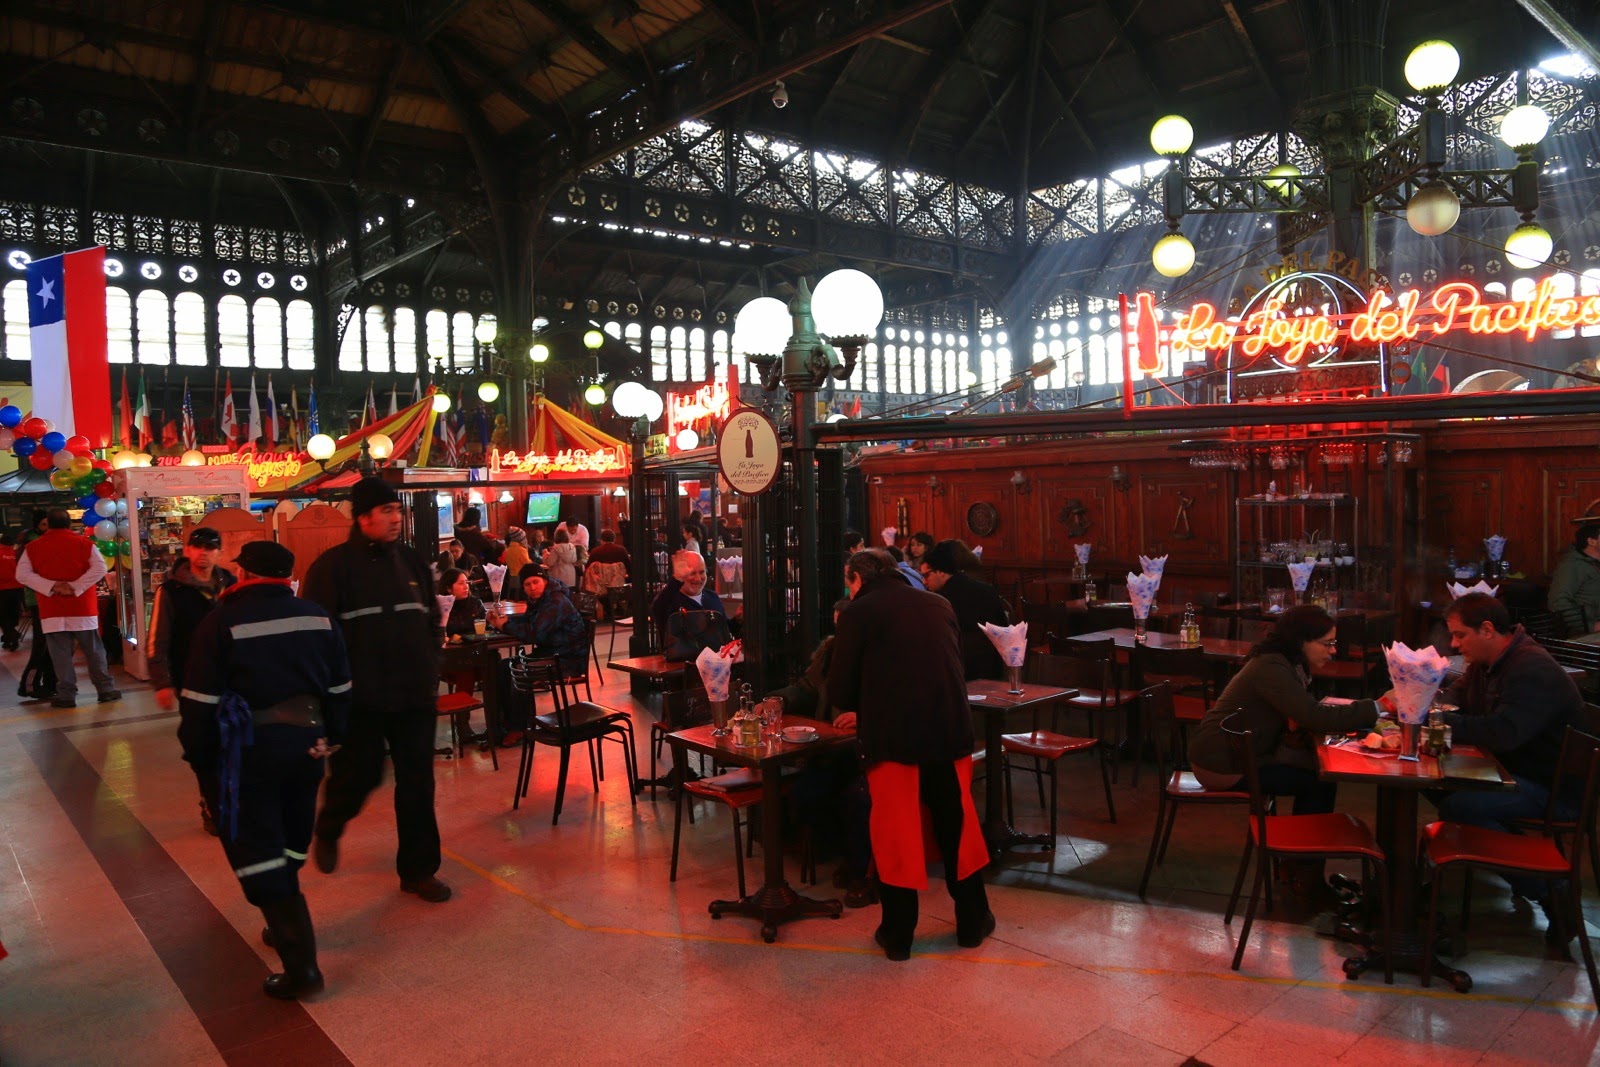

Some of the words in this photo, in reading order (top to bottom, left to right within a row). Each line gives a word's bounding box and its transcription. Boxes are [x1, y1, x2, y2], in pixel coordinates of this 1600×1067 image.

[1172, 301, 1235, 352] La
[1242, 297, 1339, 363] Joya
[1351, 288, 1423, 342] del
[239, 453, 301, 487] Augusto
[502, 451, 521, 466] La
[554, 448, 573, 465] del
